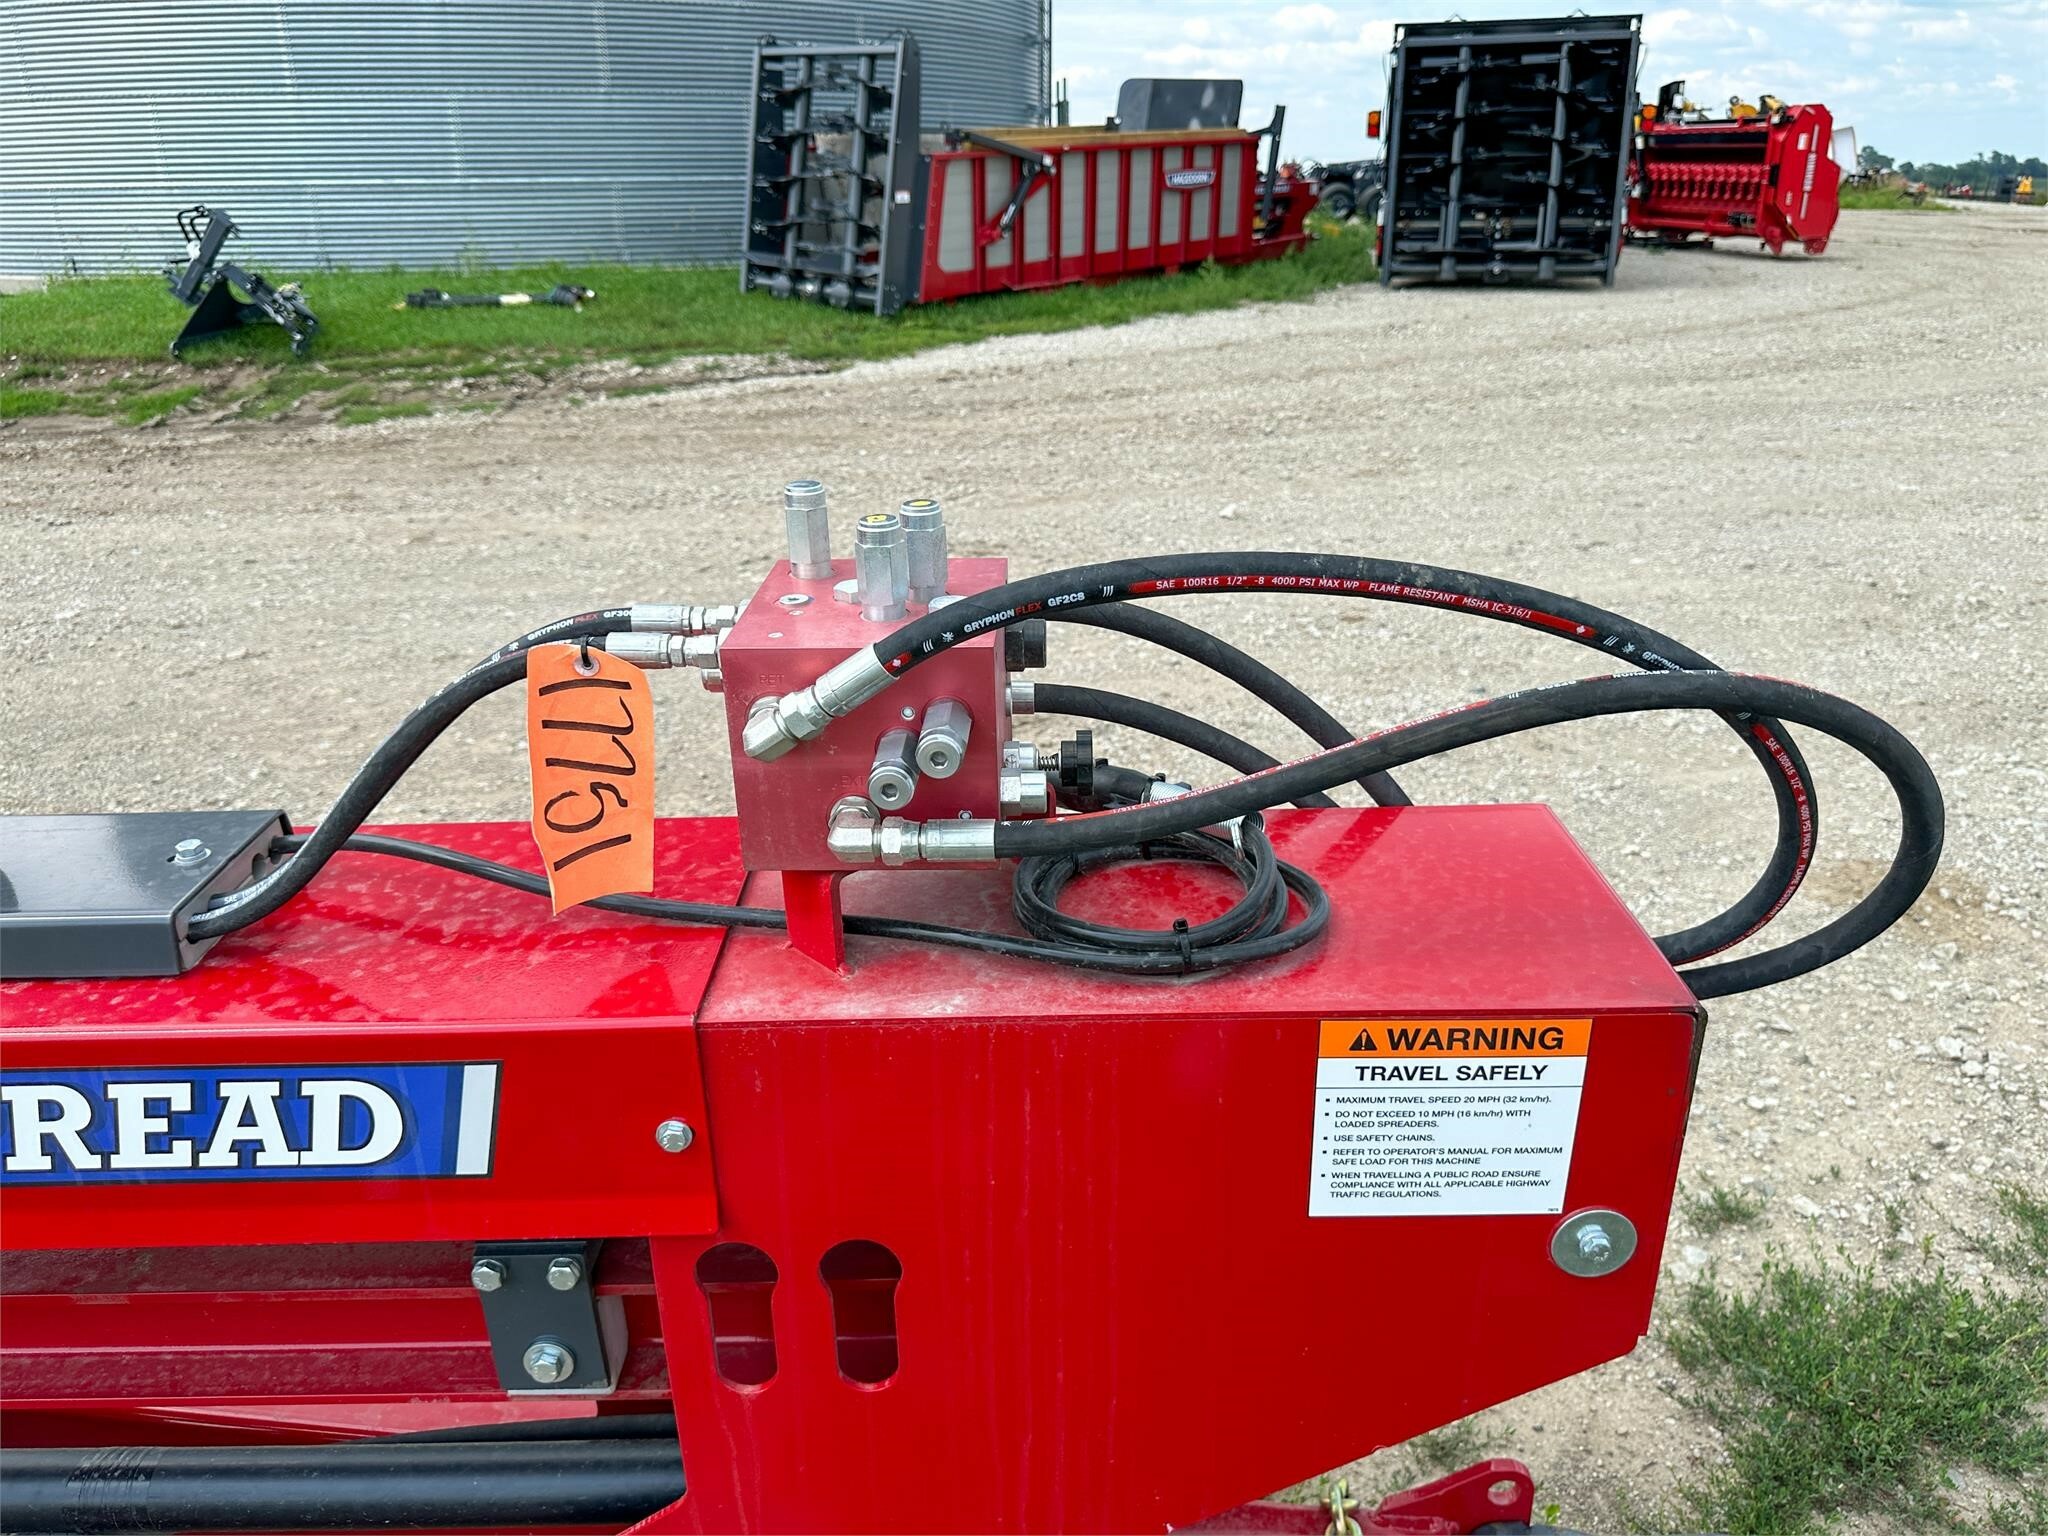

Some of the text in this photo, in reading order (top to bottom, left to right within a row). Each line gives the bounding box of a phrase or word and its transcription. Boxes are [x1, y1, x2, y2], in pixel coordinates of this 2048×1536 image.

[1047, 591, 1085, 607] GF2C8
[1156, 576, 1532, 619] SAE 100R16 1/2" -8 4000 PSI MAX WP FLAME RESISTANT MSHA IC-316/1
[1765, 737, 1780, 752] SAE
[1776, 751, 1796, 776] 100R16
[538, 678, 637, 872] 17751
[1386, 1026, 1564, 1051] WARNING
[1354, 1064, 1549, 1081] TRAVEL SAFELY
[1336, 1096, 1552, 1104] MAXIMUM TRAVEL SPEED 20 MPH (32 km/hr).
[1335, 1110, 1531, 1118] DO NOT EXCEED 10 MPH (16 km/hr) WITH
[0, 1079, 403, 1171] READ
[1334, 1120, 1439, 1128] LOADED SPREADERS.
[1332, 1147, 1563, 1156] REFER TO OPERATOR'S MANUAL FOR MAXIMUM
[1331, 1170, 1542, 1179] WHEN TRAVELLING A PUBLIC ROAD ENSURE
[1330, 1180, 1551, 1189] COMPLIANCE WITH ALL APPLICABLE HIGHWAY
